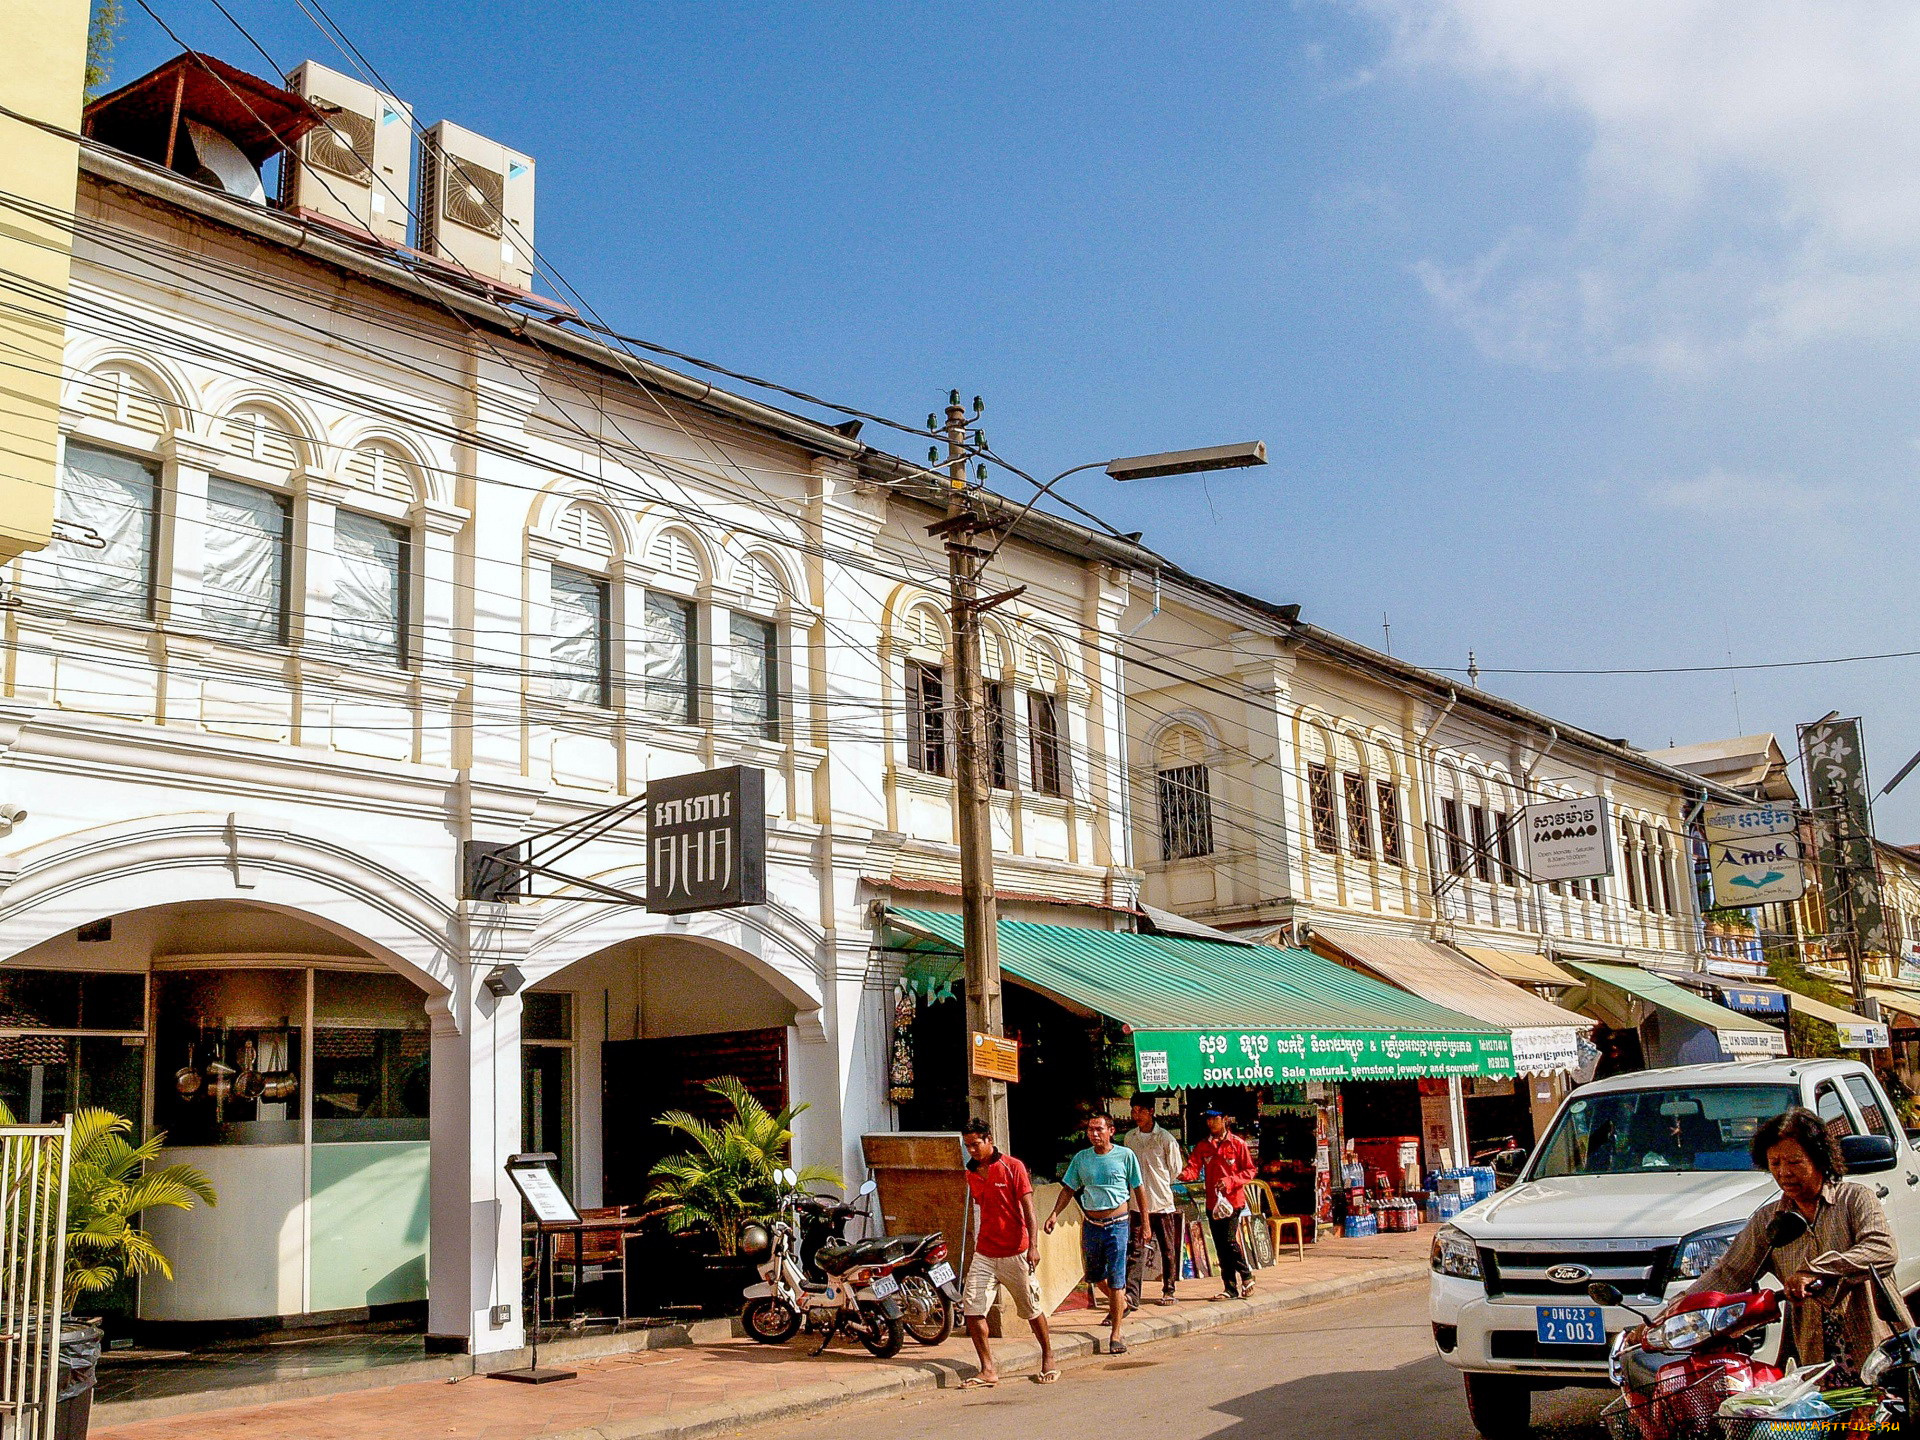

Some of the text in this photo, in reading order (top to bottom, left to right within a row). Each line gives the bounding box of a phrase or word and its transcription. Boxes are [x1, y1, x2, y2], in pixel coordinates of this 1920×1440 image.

[1716, 843, 1789, 869] Amok
[1204, 1068, 1233, 1080] SOK
[1236, 1066, 1274, 1079] LONG
[1282, 1066, 1306, 1077] Sale
[1351, 1065, 1394, 1077] gemstone
[1398, 1064, 1426, 1075] jewelry
[1430, 1064, 1444, 1072] and
[1446, 1063, 1479, 1072] souvenir
[1555, 1268, 1580, 1279] Ford
